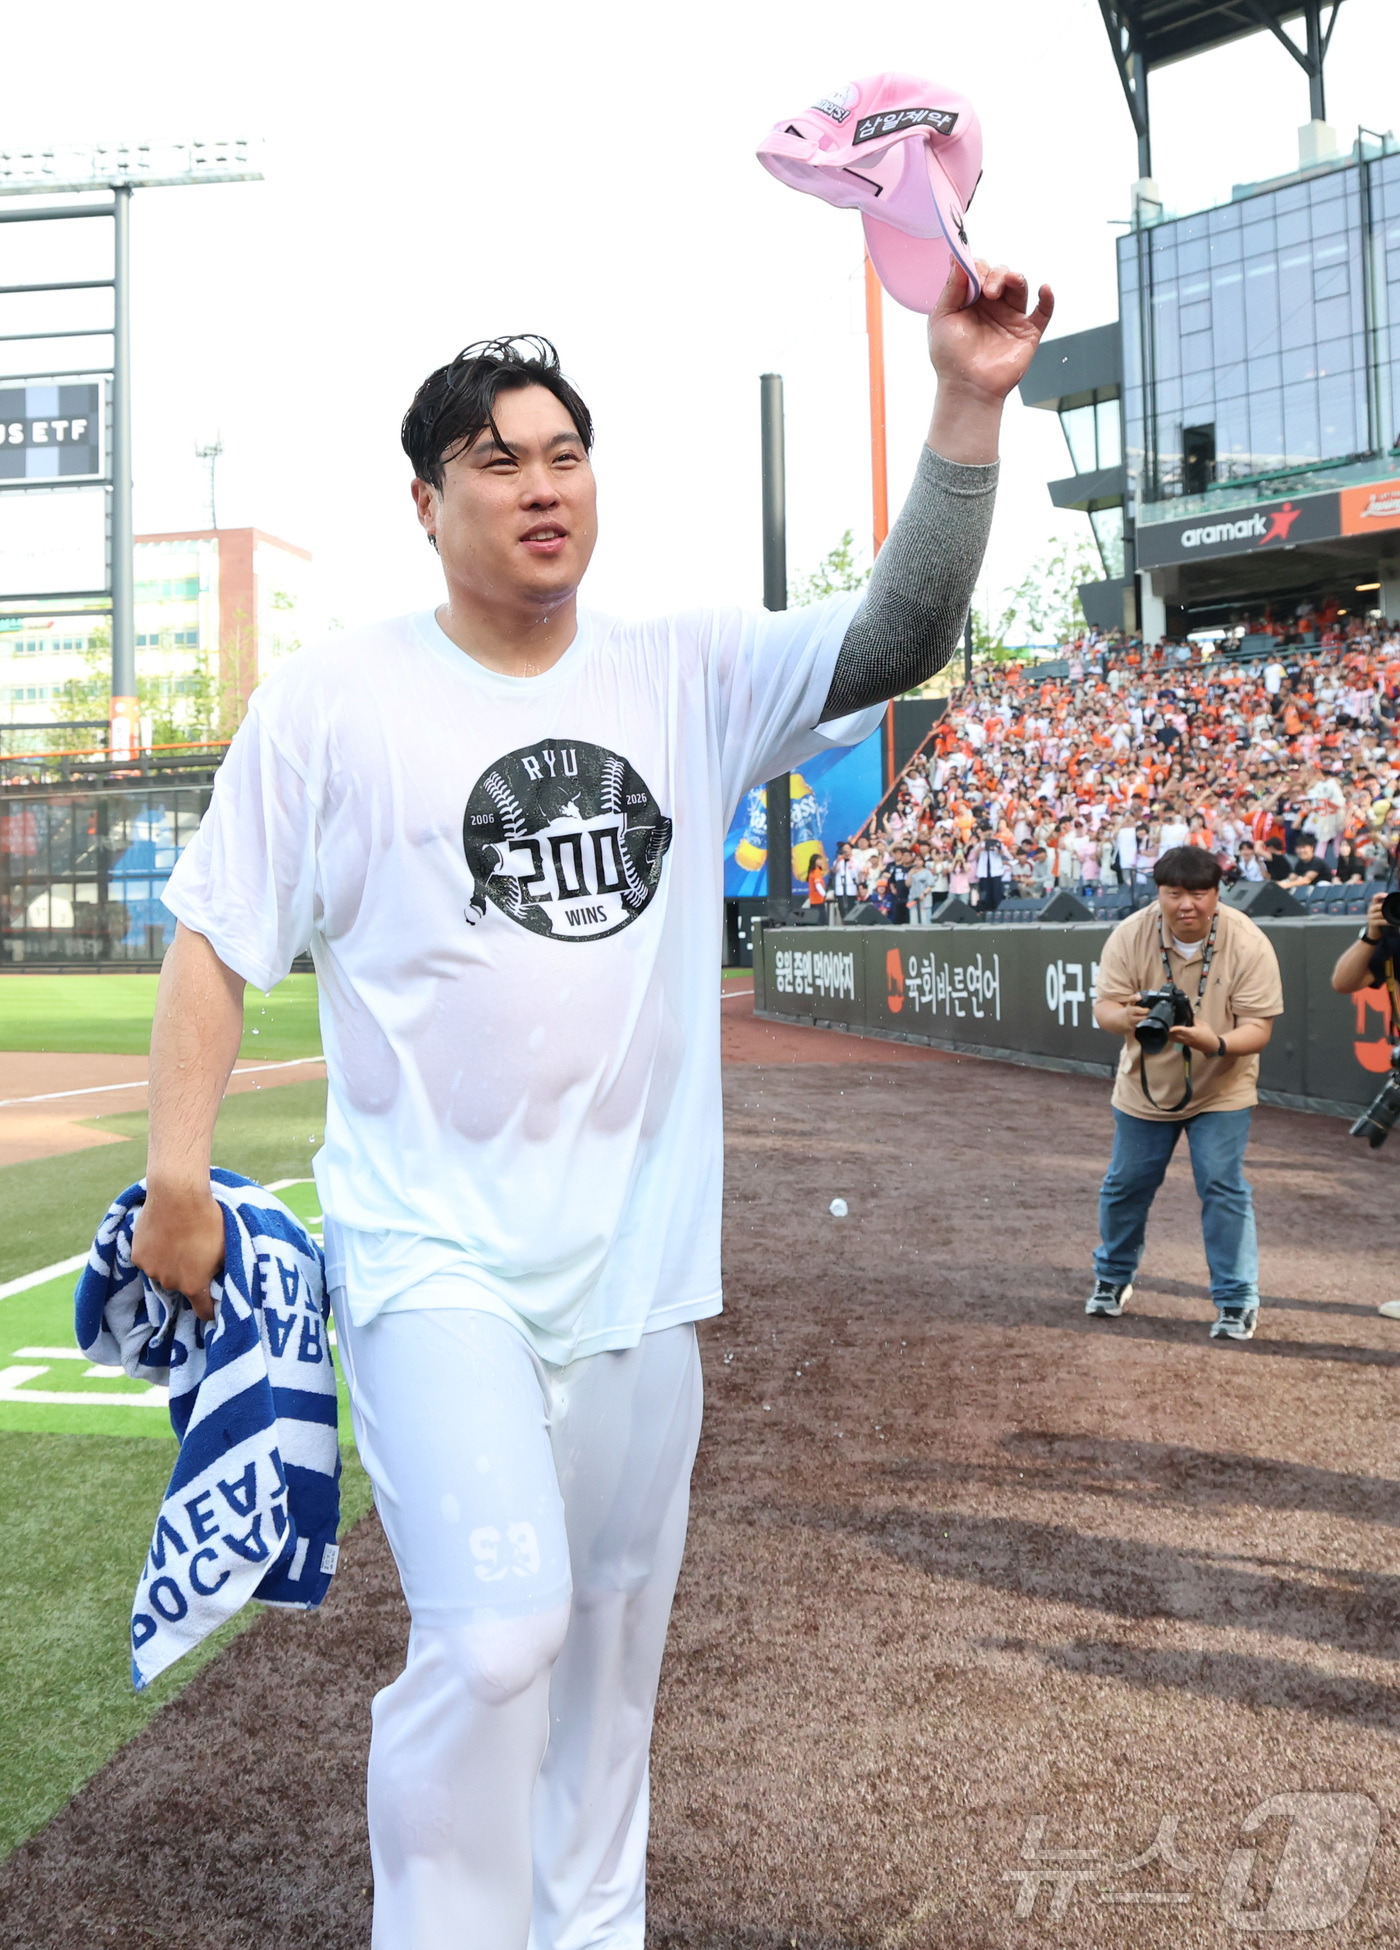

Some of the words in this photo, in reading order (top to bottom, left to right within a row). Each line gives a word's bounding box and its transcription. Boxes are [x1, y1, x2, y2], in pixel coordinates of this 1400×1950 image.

[859, 109, 953, 138] 삼일제약
[32, 418, 88, 443] ETF
[1180, 512, 1268, 548] aramark
[521, 748, 579, 781] RYU
[626, 793, 648, 806] 2026
[471, 813, 495, 826] 2006
[509, 827, 633, 904] 200
[565, 905, 608, 927] WINS
[1045, 959, 1086, 1027] 야구
